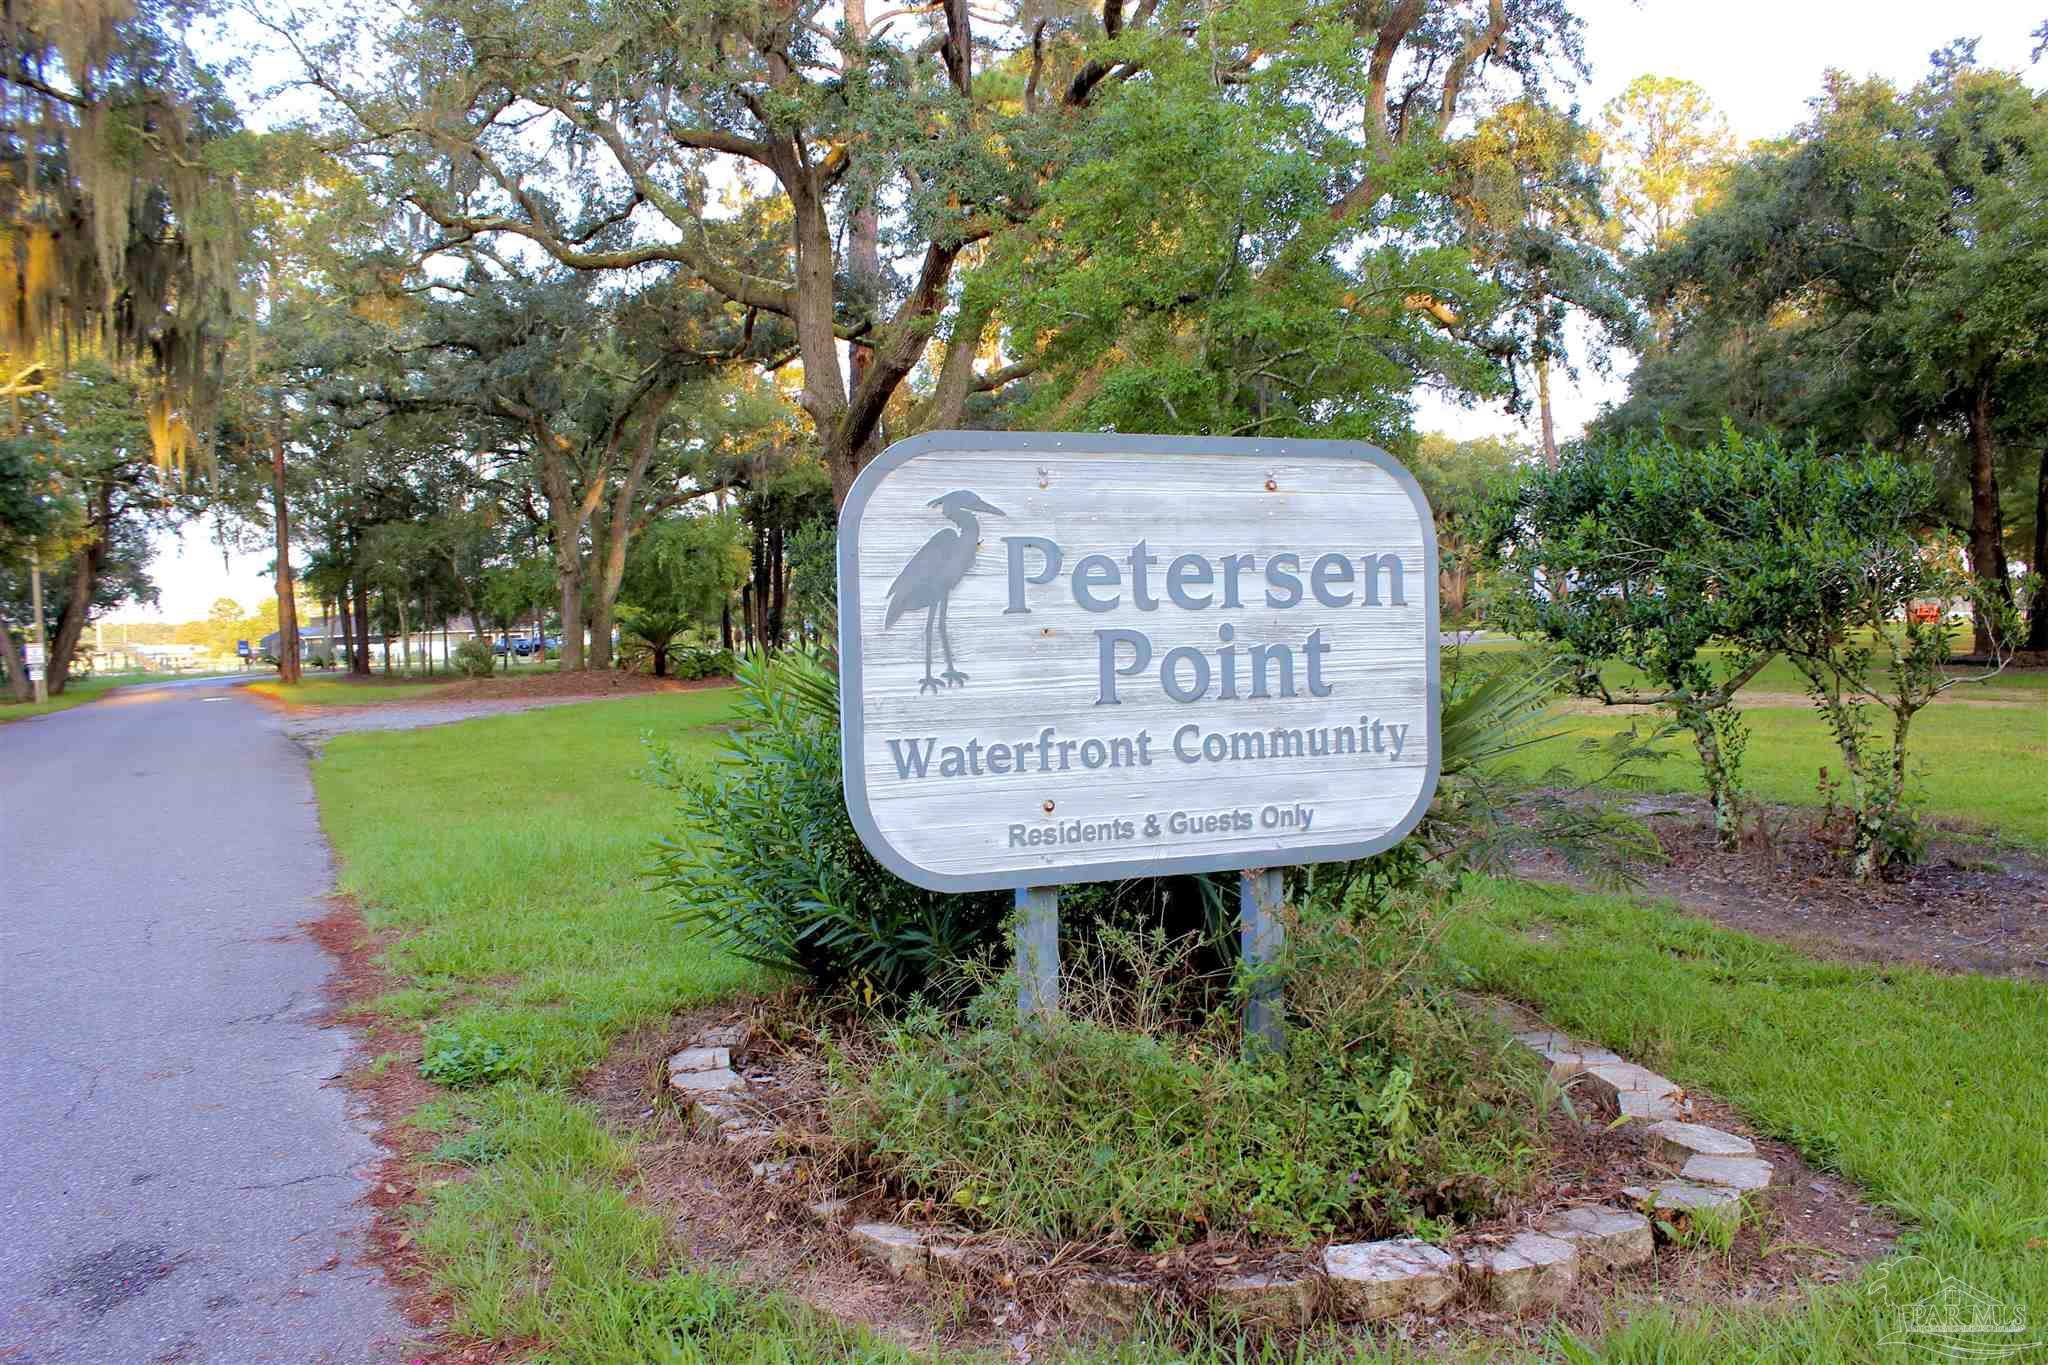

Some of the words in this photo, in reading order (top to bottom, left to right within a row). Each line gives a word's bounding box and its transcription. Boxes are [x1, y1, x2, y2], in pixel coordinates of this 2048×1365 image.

[1001, 536, 1409, 615] Petersen
[1093, 623, 1334, 707] Point
[886, 727, 1153, 780] Waterfront
[1172, 715, 1409, 764] Community
[1008, 817, 1135, 848] Residents
[1143, 814, 1162, 839] &
[1168, 808, 1253, 835] Guests
[1260, 803, 1315, 832] Only
